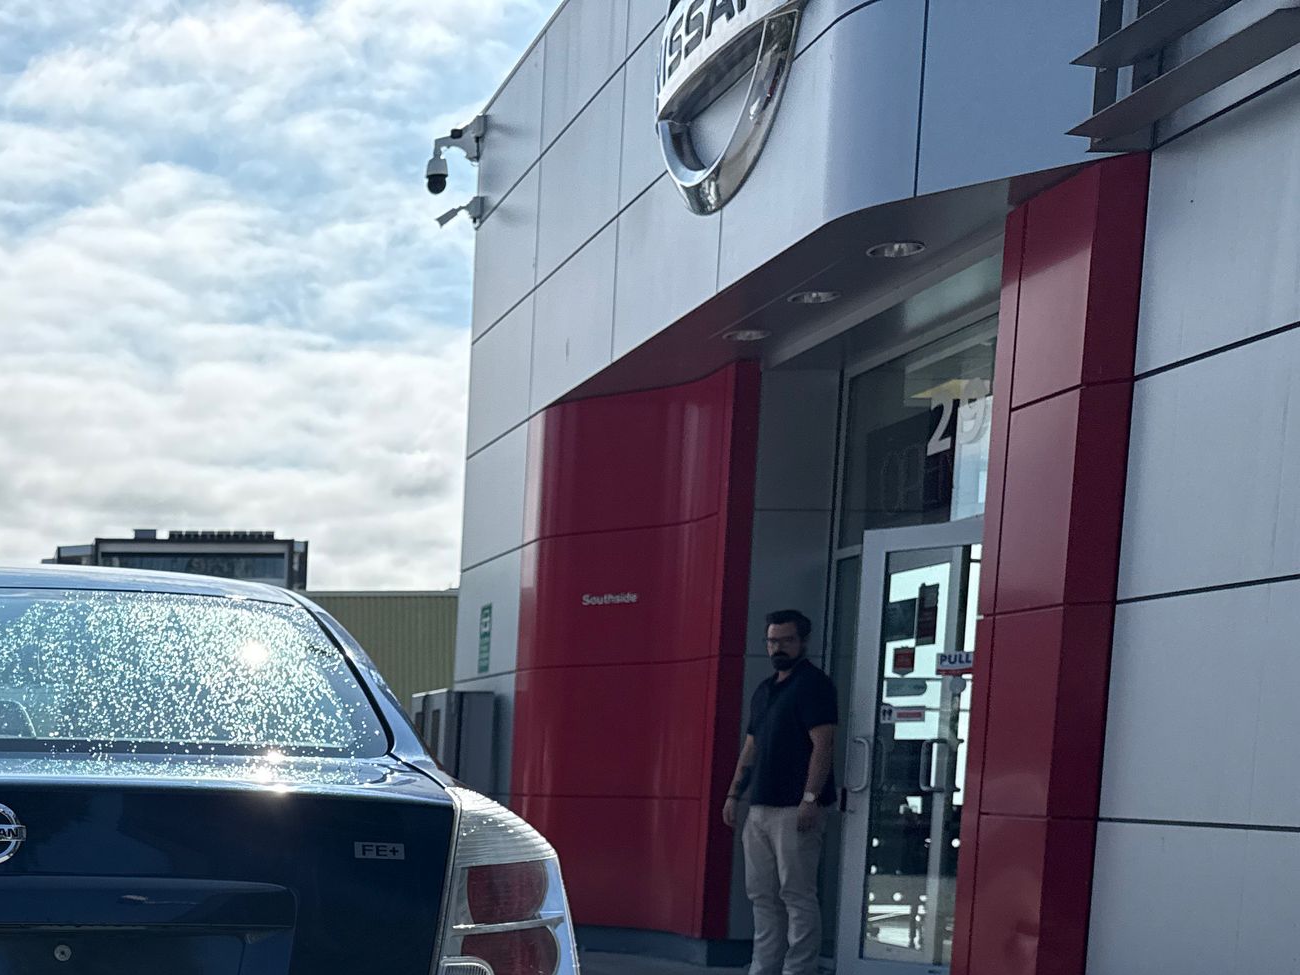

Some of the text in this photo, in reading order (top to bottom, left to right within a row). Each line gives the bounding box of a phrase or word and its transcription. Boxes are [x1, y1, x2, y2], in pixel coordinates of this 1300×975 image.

[582, 592, 637, 605] Southside
[939, 653, 972, 666] PULL
[361, 844, 399, 857] FE+
